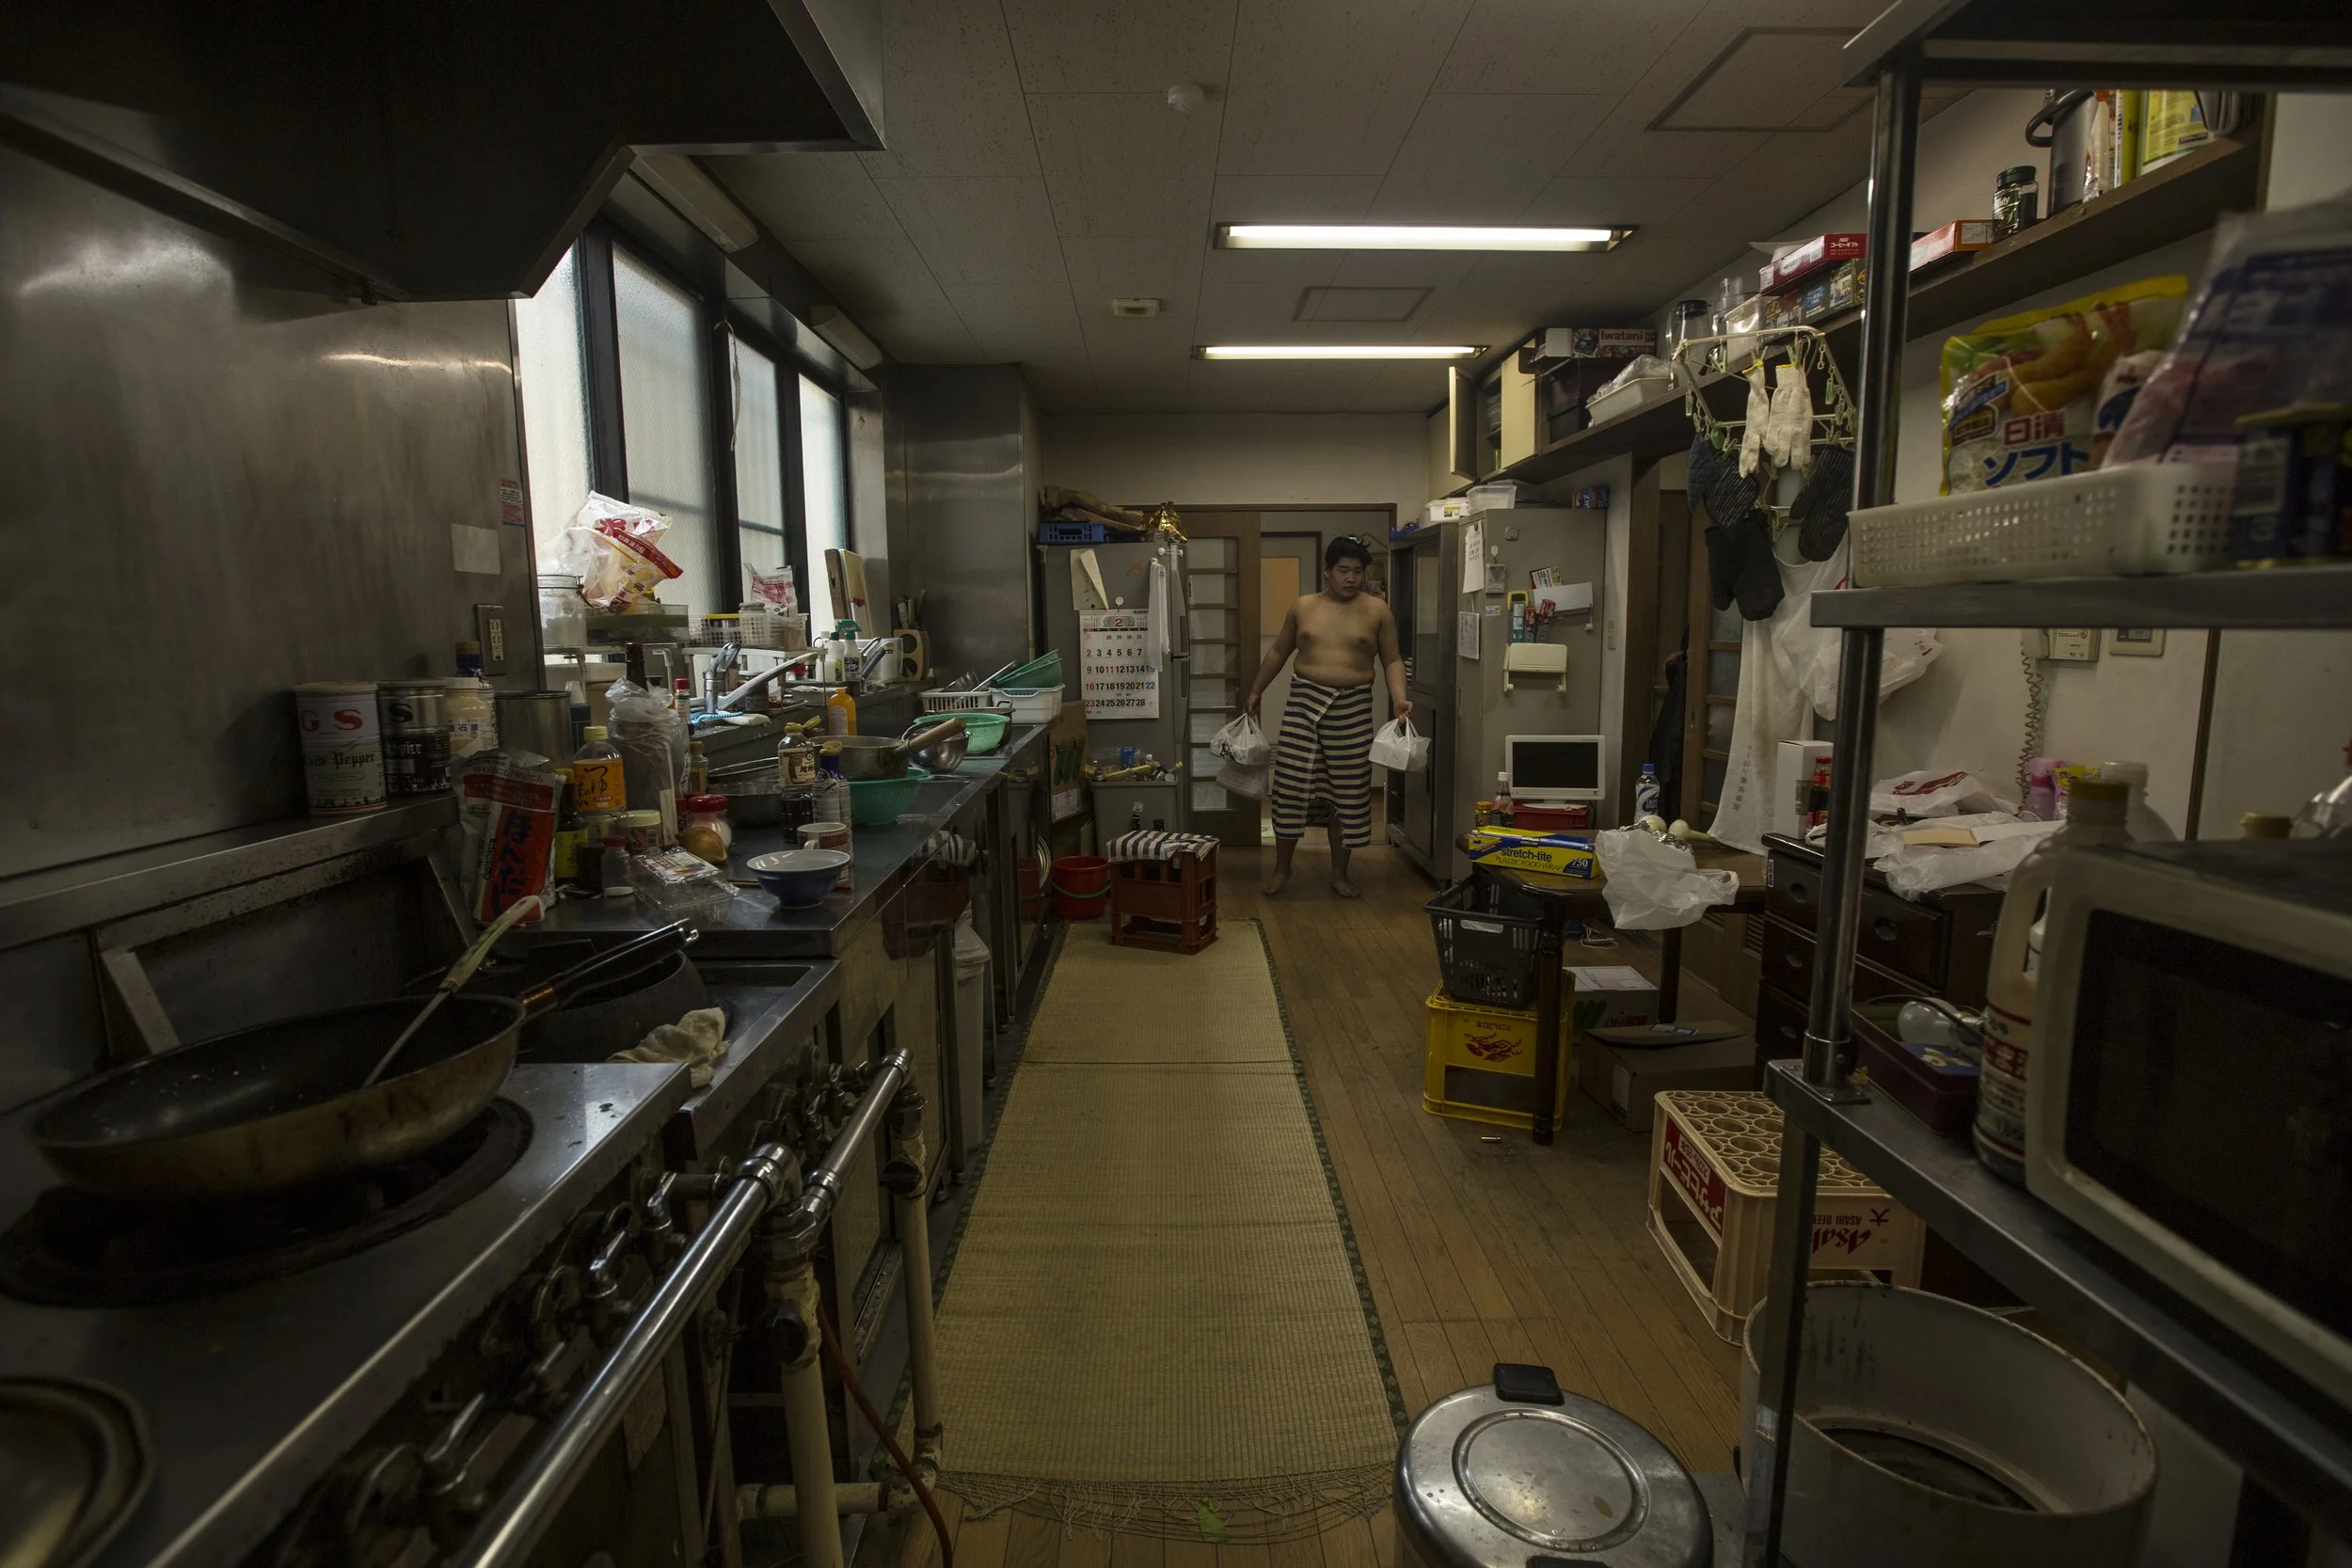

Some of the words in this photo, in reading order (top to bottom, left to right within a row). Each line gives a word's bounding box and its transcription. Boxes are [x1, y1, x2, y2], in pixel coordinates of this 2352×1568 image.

[1600, 330, 1644, 341] Iwatani
[2004, 410, 2066, 446] 日清
[1983, 441, 2090, 486] ソフト
[1114, 618, 1123, 627] 2
[1086, 649, 1092, 657] 2
[1117, 648, 1122, 657] 5
[1127, 648, 1133, 657] 6
[1095, 665, 1104, 673] 10
[1105, 665, 1114, 673] 11
[1115, 665, 1125, 673] 12
[1125, 665, 1136, 673] 13
[1095, 682, 1104, 690] 17
[1105, 682, 1115, 690] 18
[1145, 681, 1155, 689] 22
[1085, 699, 1095, 707] 23
[1095, 699, 1105, 707] 24
[1136, 698, 1146, 706] 28
[331, 752, 375, 769] Pepper
[583, 765, 609, 796] つゆ
[1501, 847, 1552, 863] stretch-tite
[1495, 856, 1520, 866] PLASTIC
[1520, 859, 1541, 868] FOOD
[1541, 862, 1564, 871] WRAP
[1571, 858, 1589, 868] 750
[1664, 1140, 1724, 1230] アサヒビール
[1835, 1214, 1862, 1226] ASAHI
[1869, 1208, 1890, 1227] 大
[1812, 1227, 1872, 1255] Asa
